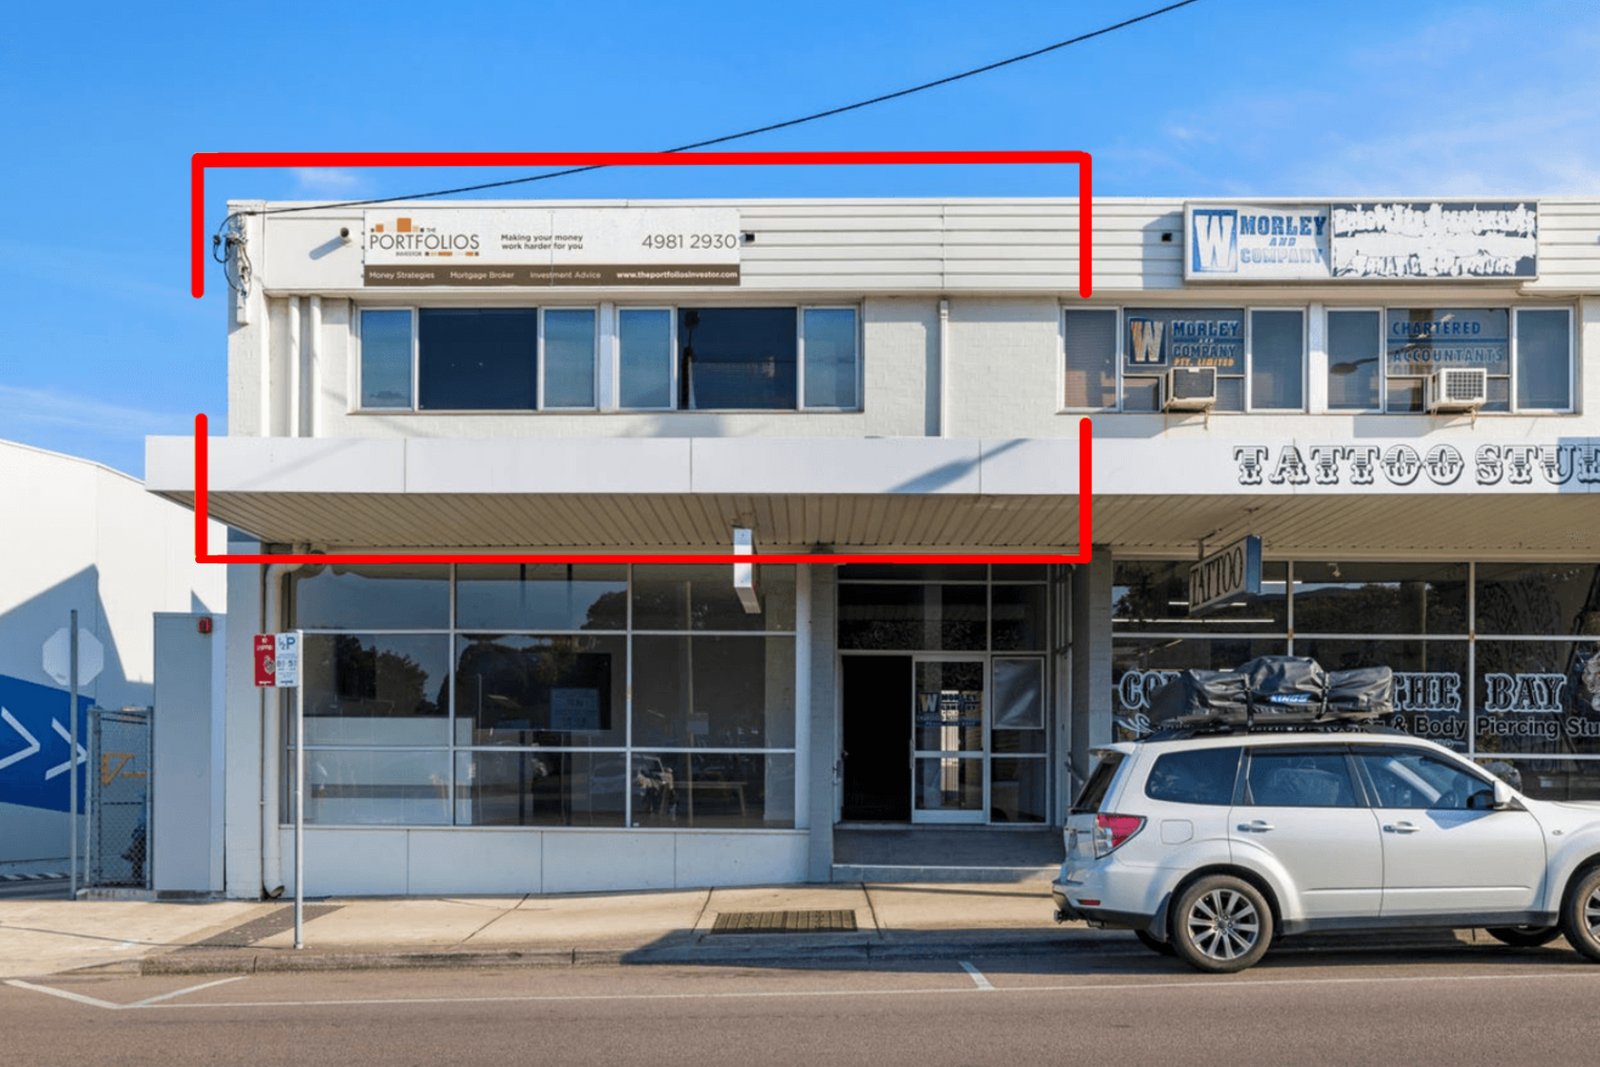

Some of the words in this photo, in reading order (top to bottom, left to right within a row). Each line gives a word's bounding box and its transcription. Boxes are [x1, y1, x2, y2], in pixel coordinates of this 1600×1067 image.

[1240, 216, 1327, 236] MORLEY
[370, 234, 480, 250] PORTFOLIOS
[501, 233, 531, 242] Making
[641, 234, 684, 249] 4981
[690, 234, 737, 249] 2930
[1269, 237, 1297, 247] AND
[553, 242, 565, 250] for
[1240, 248, 1323, 263] COMPANY
[450, 271, 487, 280] Mortgage
[489, 271, 514, 279] Broker
[575, 271, 601, 279] Advice
[1172, 321, 1239, 337] MORLEY
[1392, 322, 1481, 335] CHARTERED
[1172, 344, 1236, 357] COMPANY
[1393, 348, 1504, 362] ACCOUNTANTS
[1197, 358, 1235, 367] LIMITED
[1233, 444, 1465, 486] TATTOO
[1190, 546, 1244, 608] TATTOO
[1485, 673, 1567, 712] BAY
[1415, 717, 1466, 738] Body
[1476, 716, 1560, 741] Piercing
